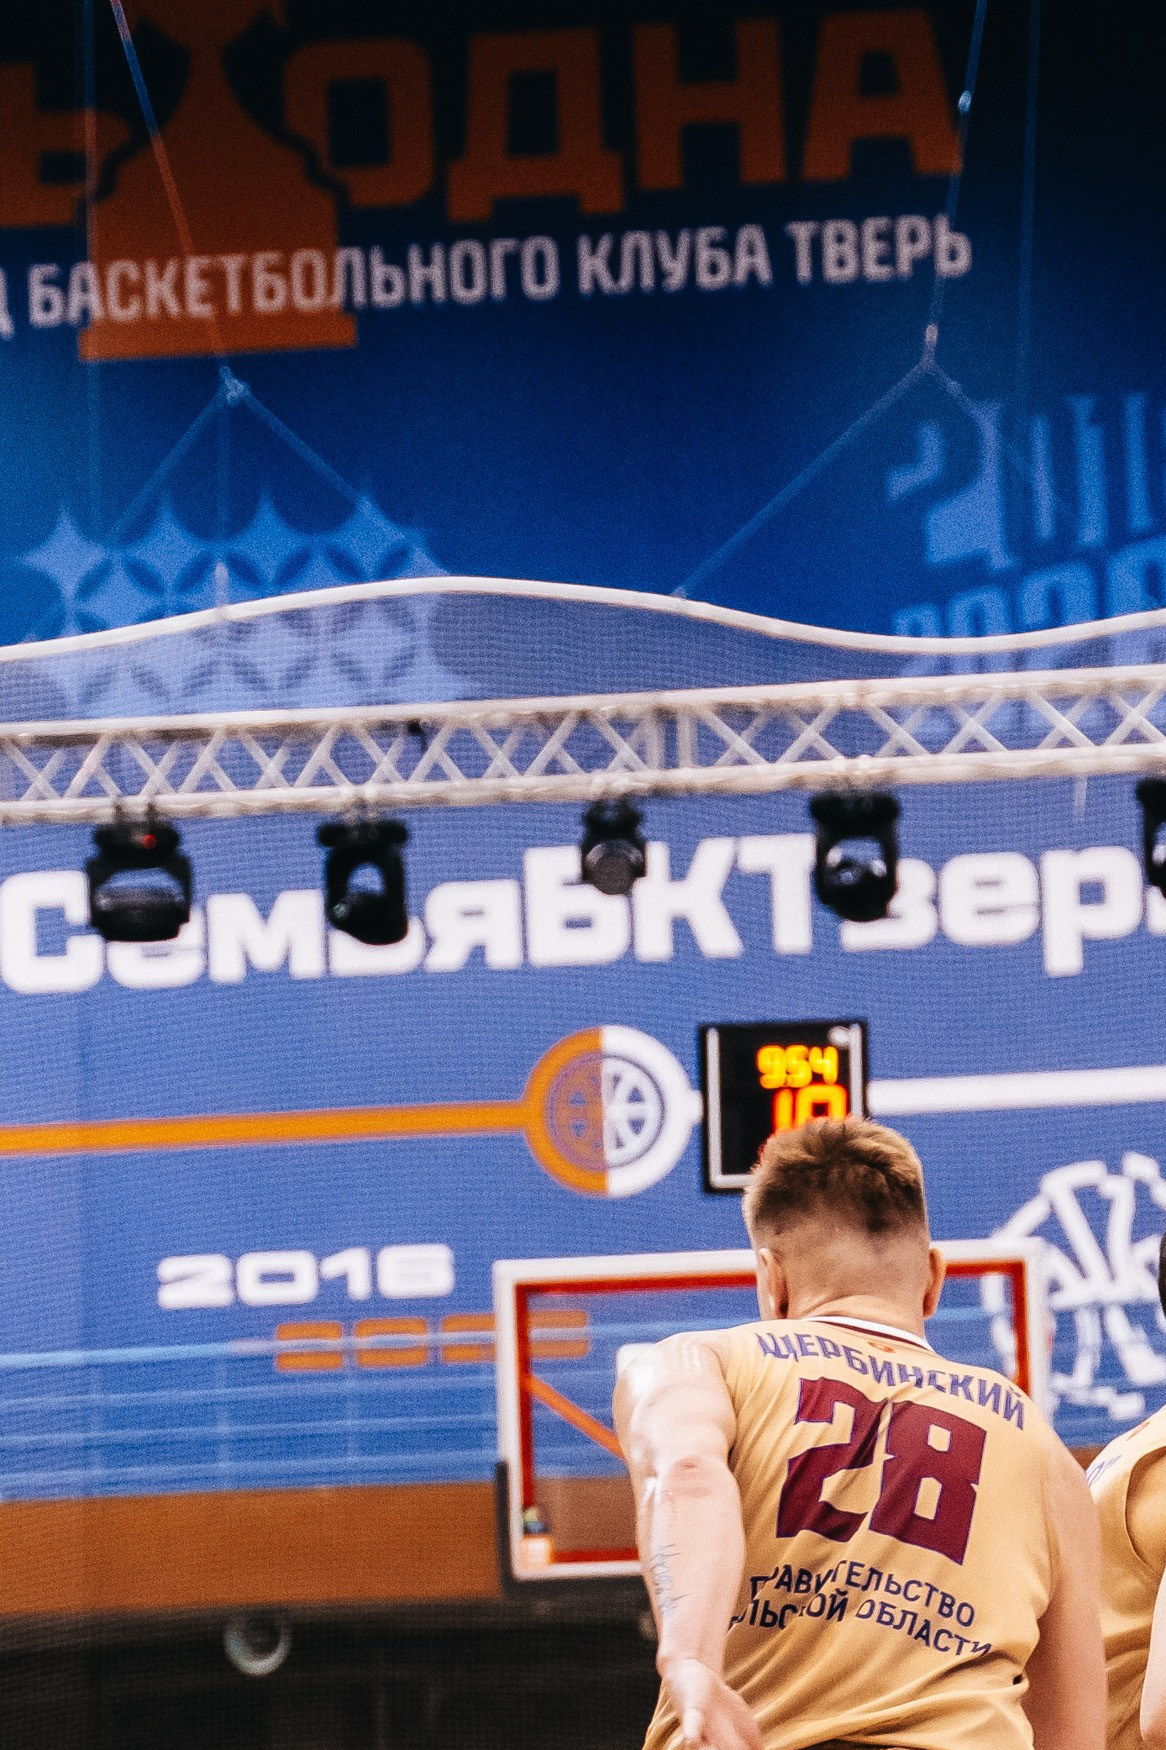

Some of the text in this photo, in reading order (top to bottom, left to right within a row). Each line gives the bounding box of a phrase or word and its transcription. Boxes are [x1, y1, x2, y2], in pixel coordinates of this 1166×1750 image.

[282, 8, 964, 224] ОДНА
[27, 236, 560, 329] БАСКЕТБОЛЬНОГО
[577, 223, 768, 294] КЛУБА
[785, 212, 973, 283] ТВЕРЬ
[156, 1243, 455, 1310] 2016
[754, 1332, 1025, 1431] ЩЕРБИНСКИЙ
[776, 1377, 988, 1566] 28
[855, 1599, 992, 1656] ОБЛАСТИ
